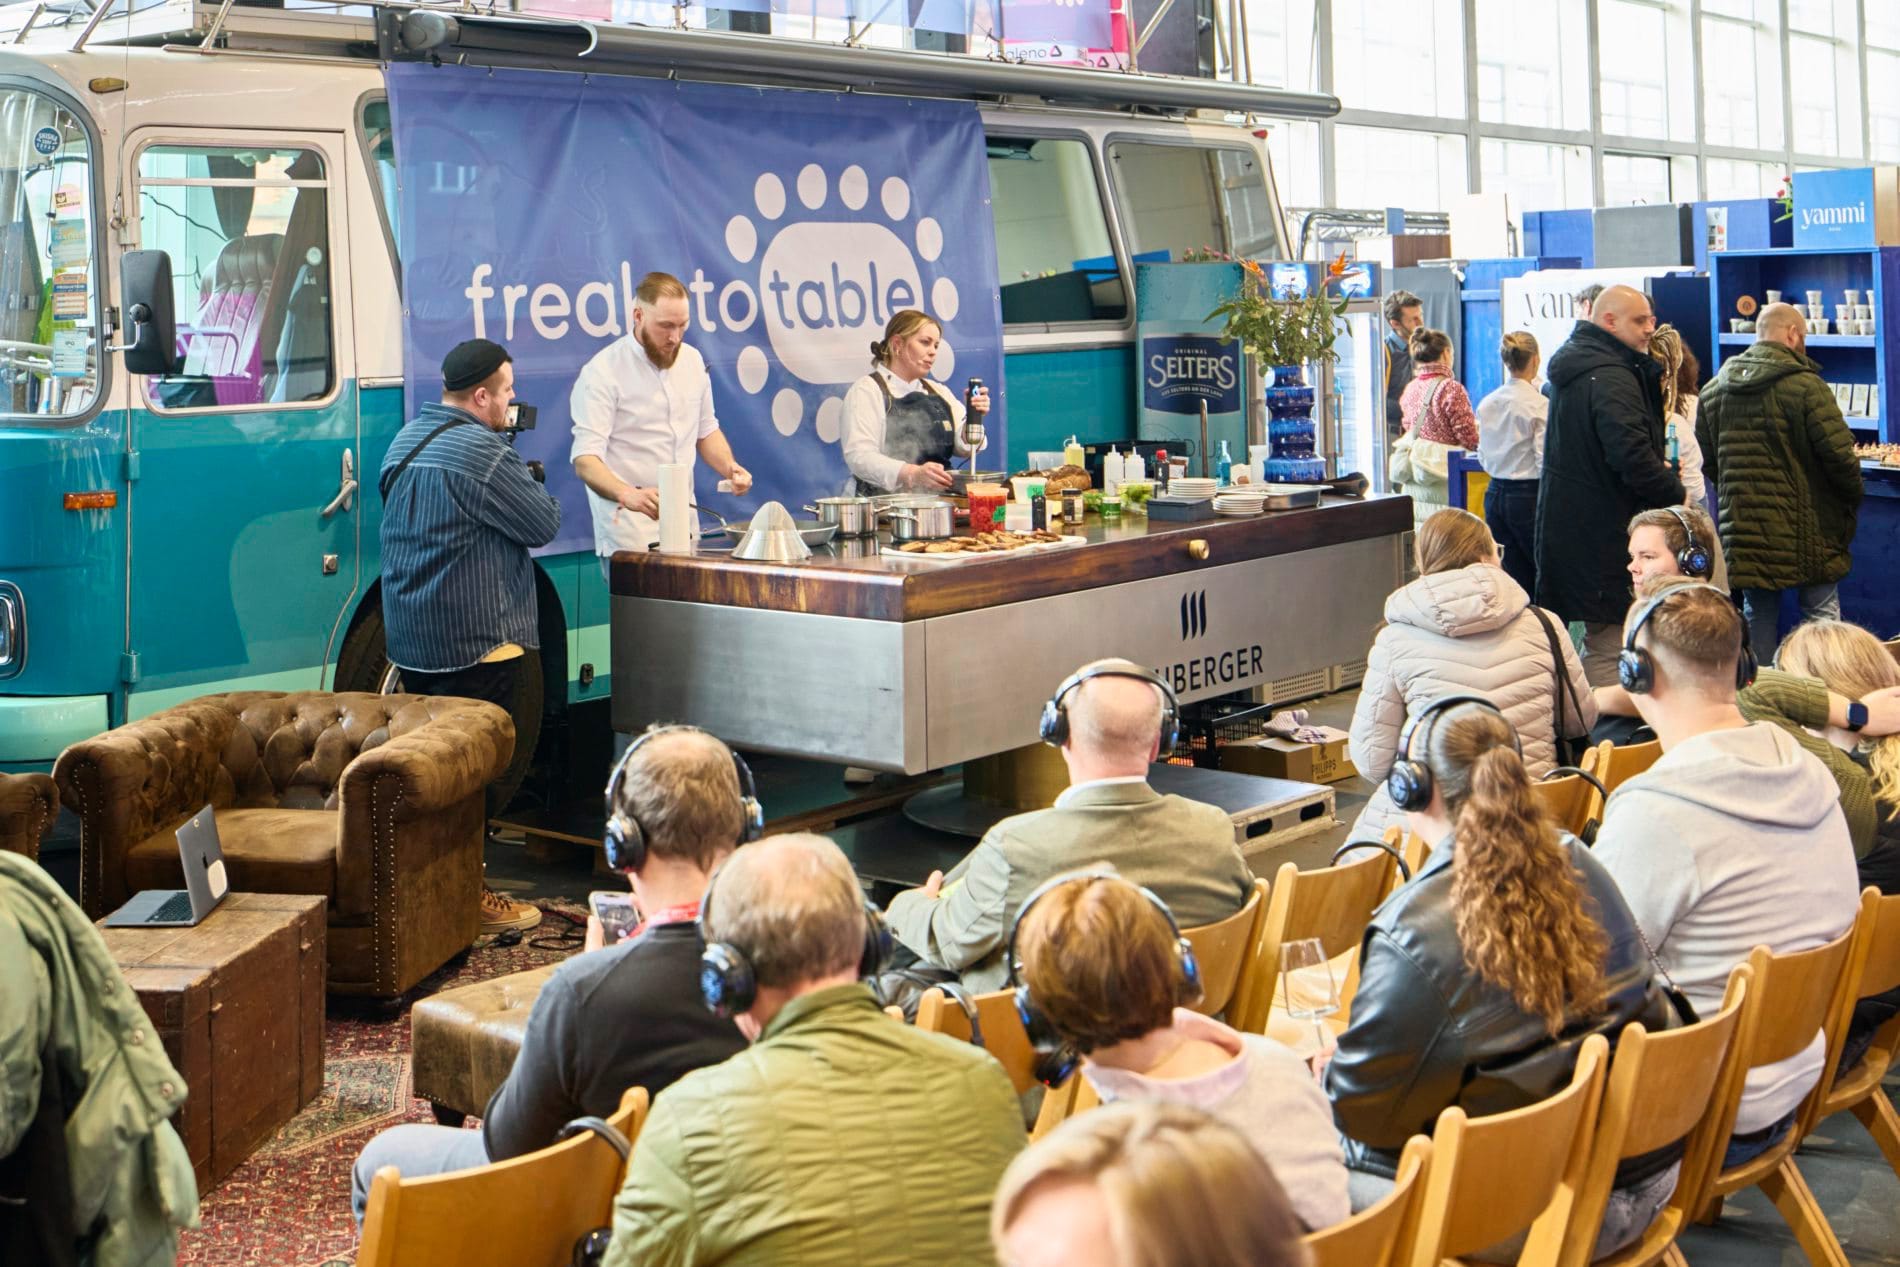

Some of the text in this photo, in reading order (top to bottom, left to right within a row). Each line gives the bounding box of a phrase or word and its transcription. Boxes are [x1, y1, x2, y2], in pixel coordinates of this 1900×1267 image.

[1801, 201, 1865, 230] yammi
[689, 268, 758, 333] to
[770, 261, 914, 330] table
[1148, 354, 1236, 390] SELTERS
